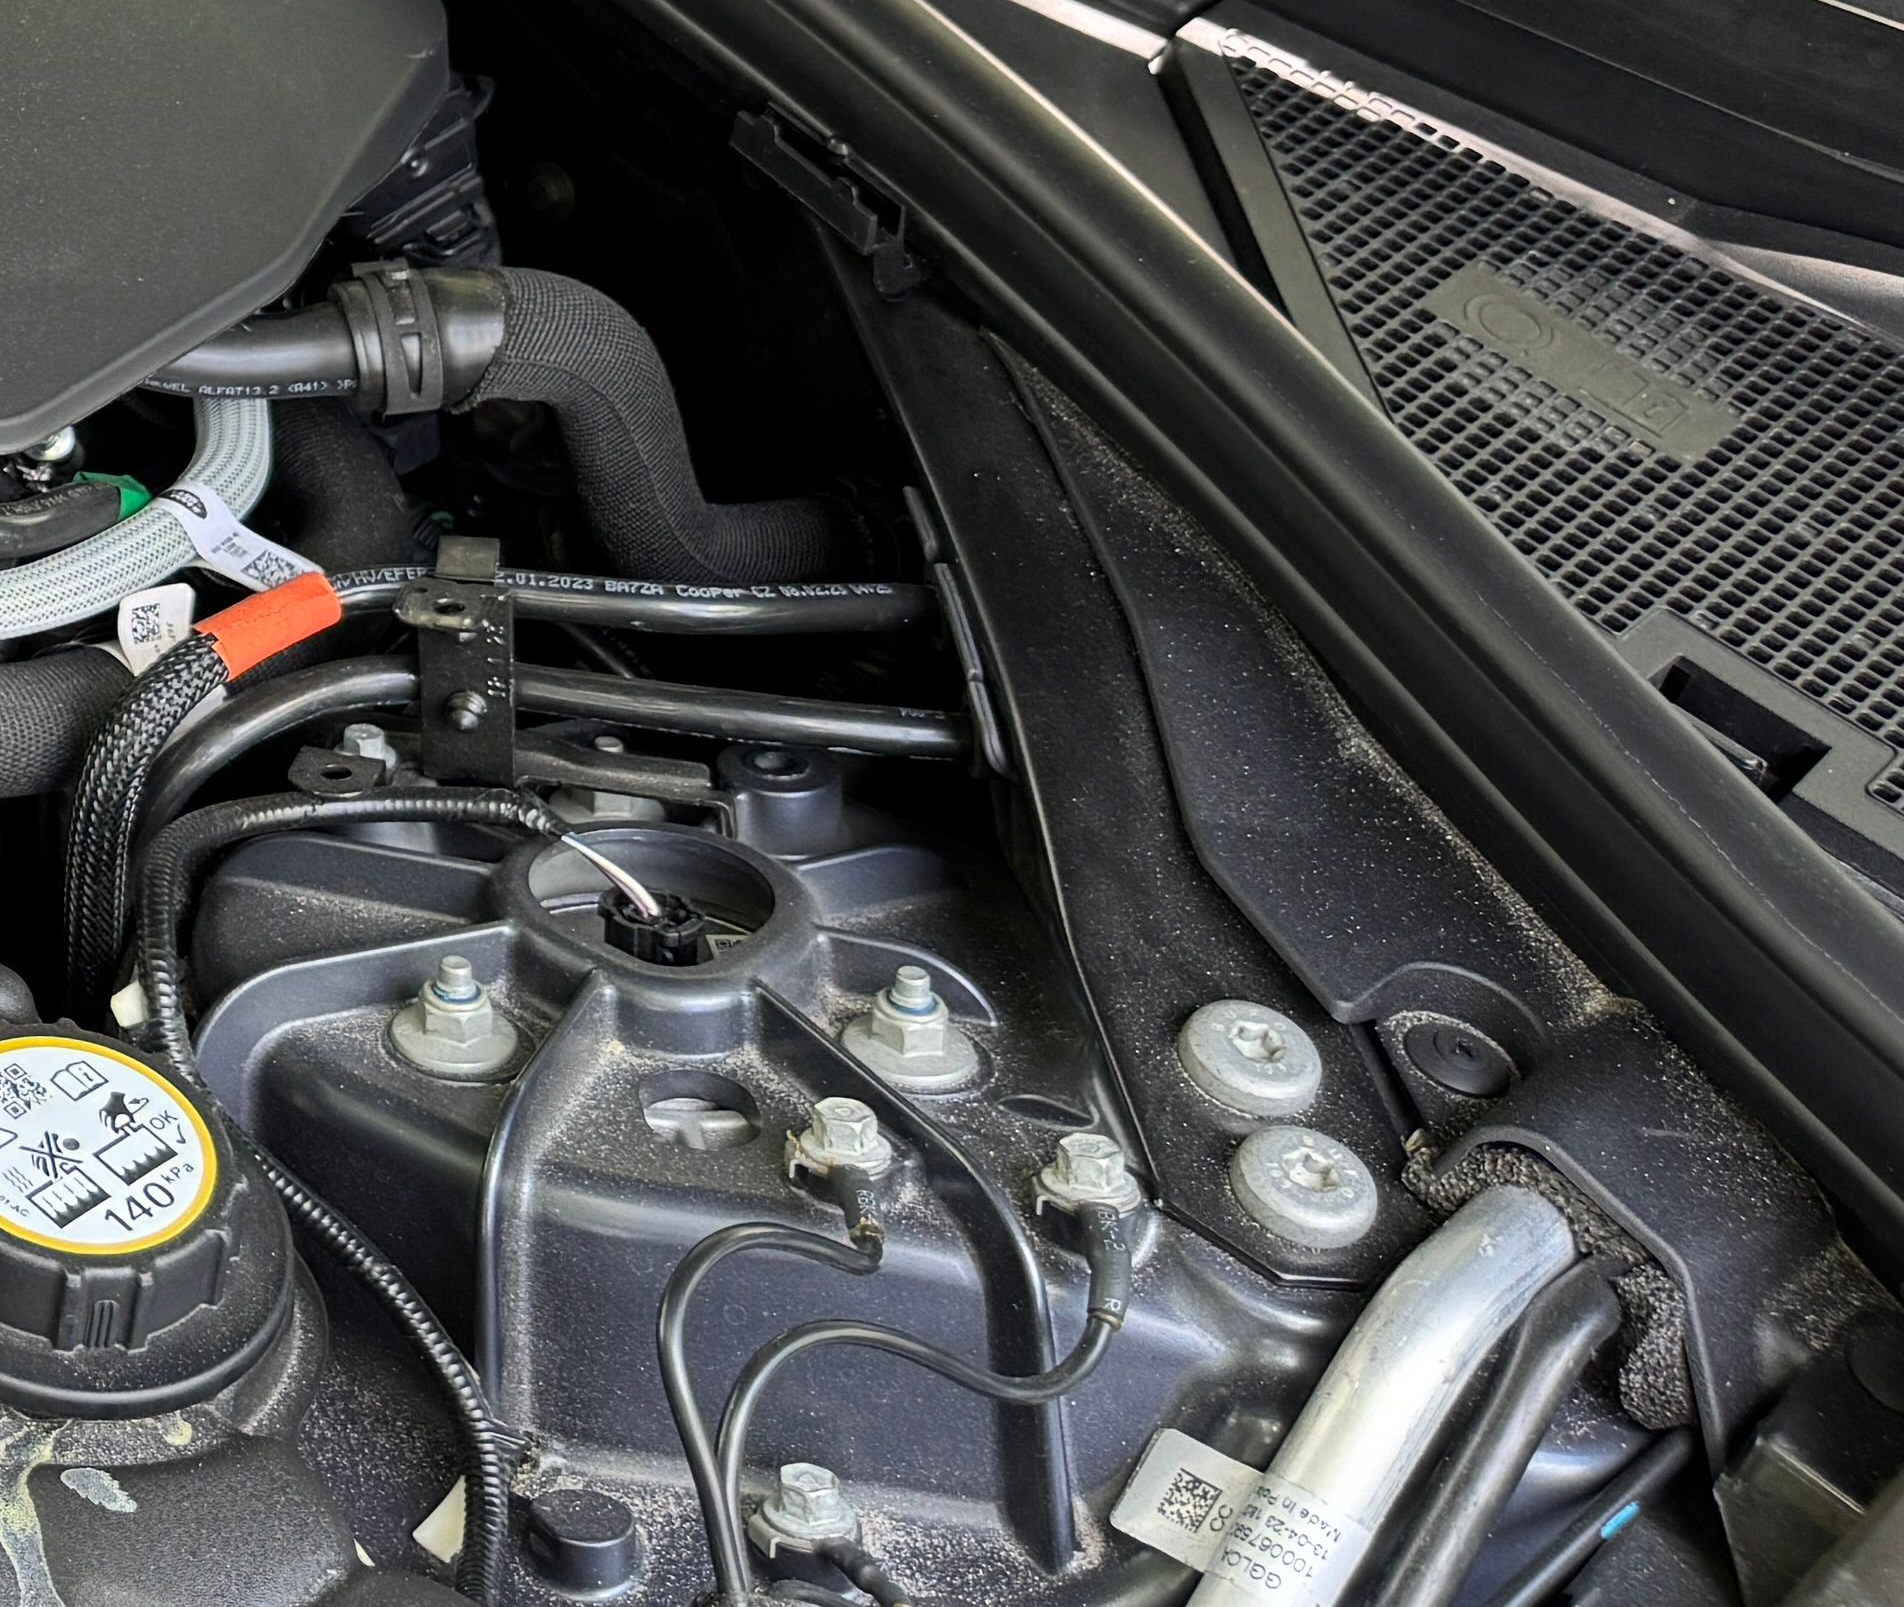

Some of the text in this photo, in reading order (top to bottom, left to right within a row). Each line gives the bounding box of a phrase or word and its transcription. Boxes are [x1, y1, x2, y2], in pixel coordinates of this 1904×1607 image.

[148, 1108, 180, 1132] OK
[103, 1163, 196, 1233] 140 kPa
